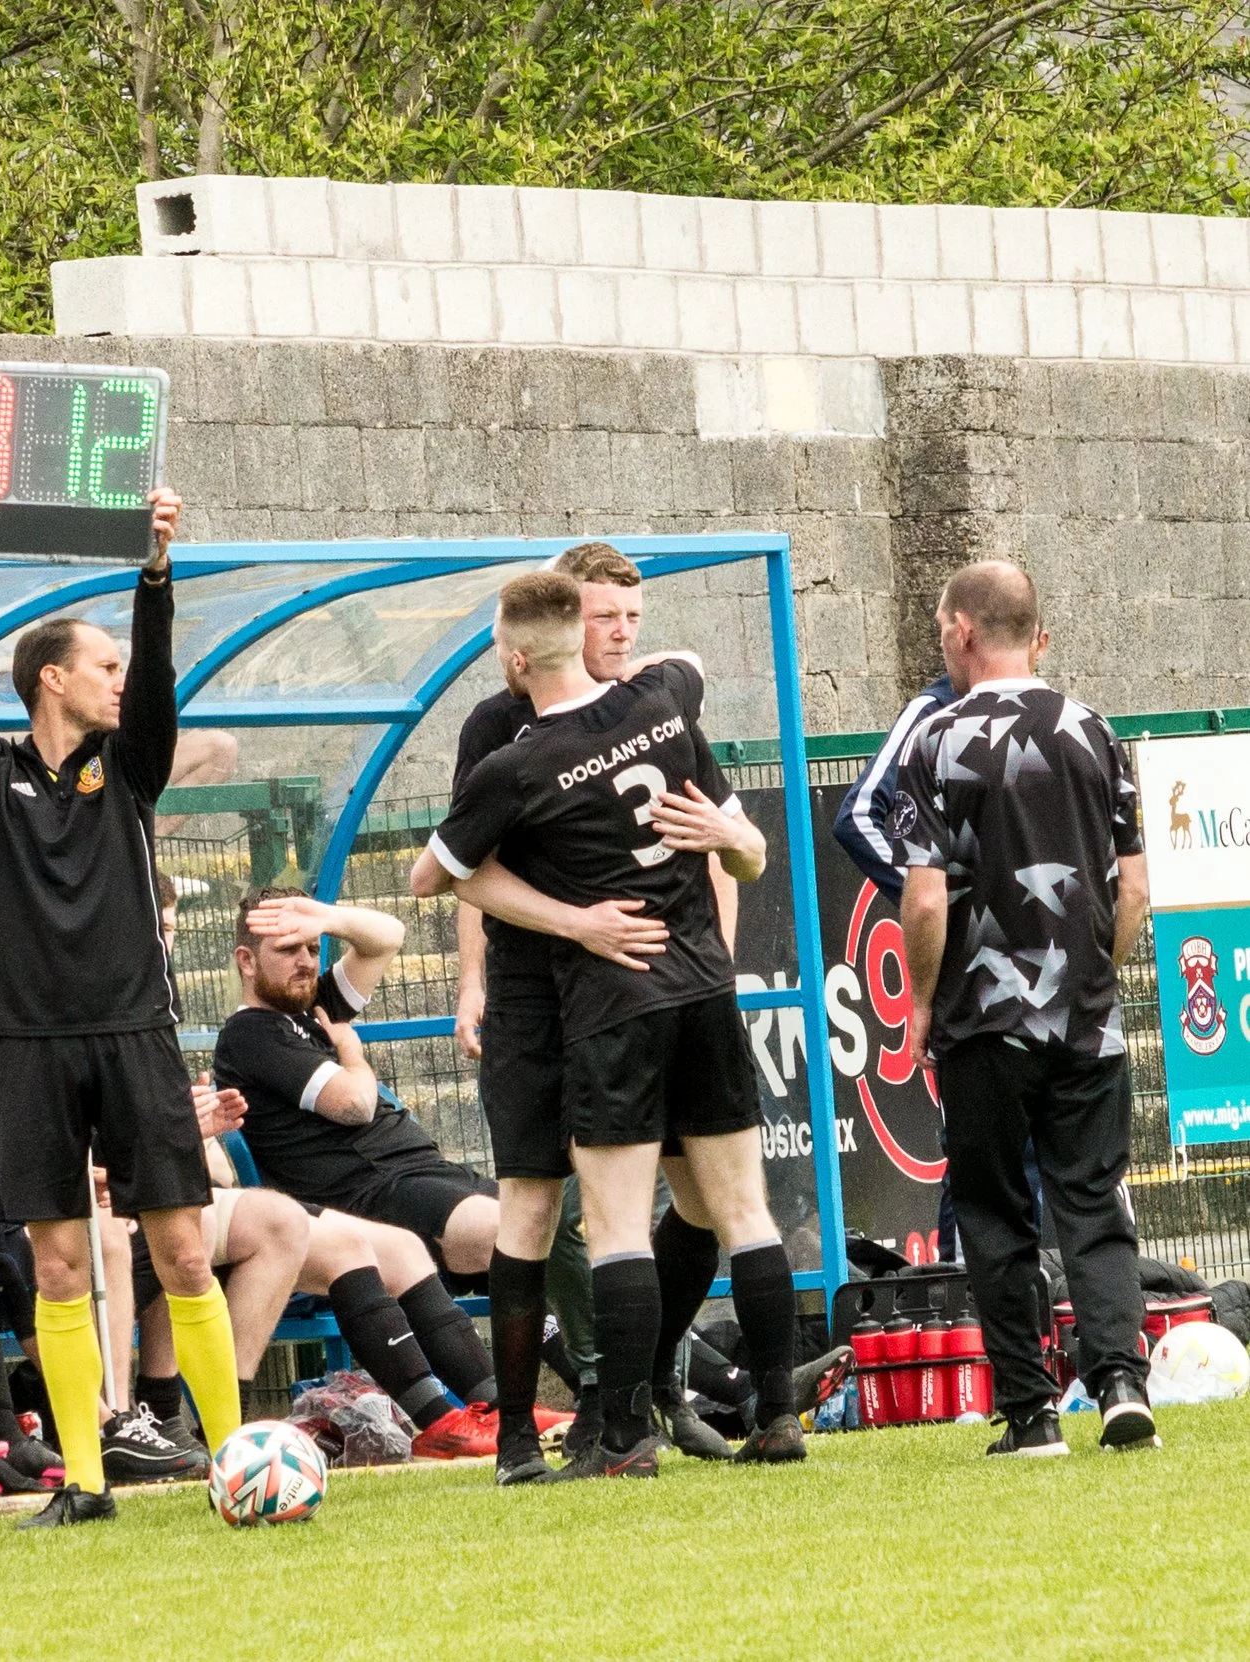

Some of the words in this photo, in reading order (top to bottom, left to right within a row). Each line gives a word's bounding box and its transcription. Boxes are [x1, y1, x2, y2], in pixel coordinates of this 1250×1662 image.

[66, 379, 157, 508] 12
[557, 734, 650, 790] DOOLAN'S
[651, 715, 685, 743] COW
[612, 763, 677, 868] 3
[760, 1121, 813, 1160] USIC
[835, 1117, 858, 1153] IX
[278, 1477, 304, 1512] mitre
